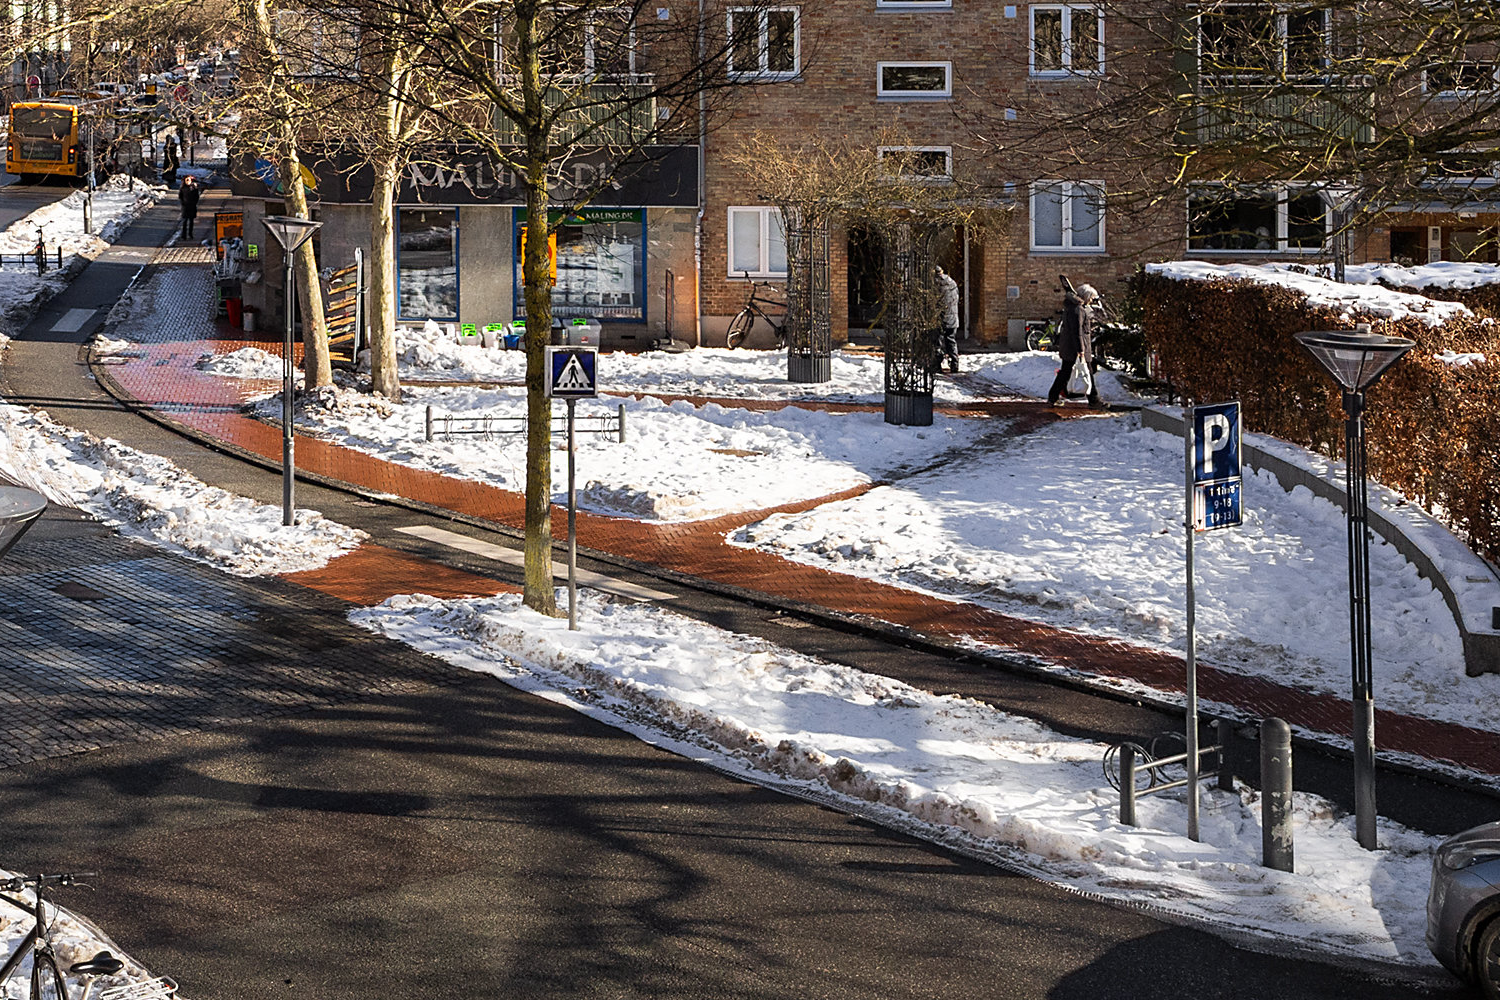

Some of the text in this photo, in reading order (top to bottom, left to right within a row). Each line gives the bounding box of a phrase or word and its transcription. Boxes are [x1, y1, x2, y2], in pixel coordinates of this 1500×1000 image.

[586, 211, 633, 220] MALING.DK
[1203, 413, 1230, 474] P
[1213, 497, 1232, 509] 9-18
